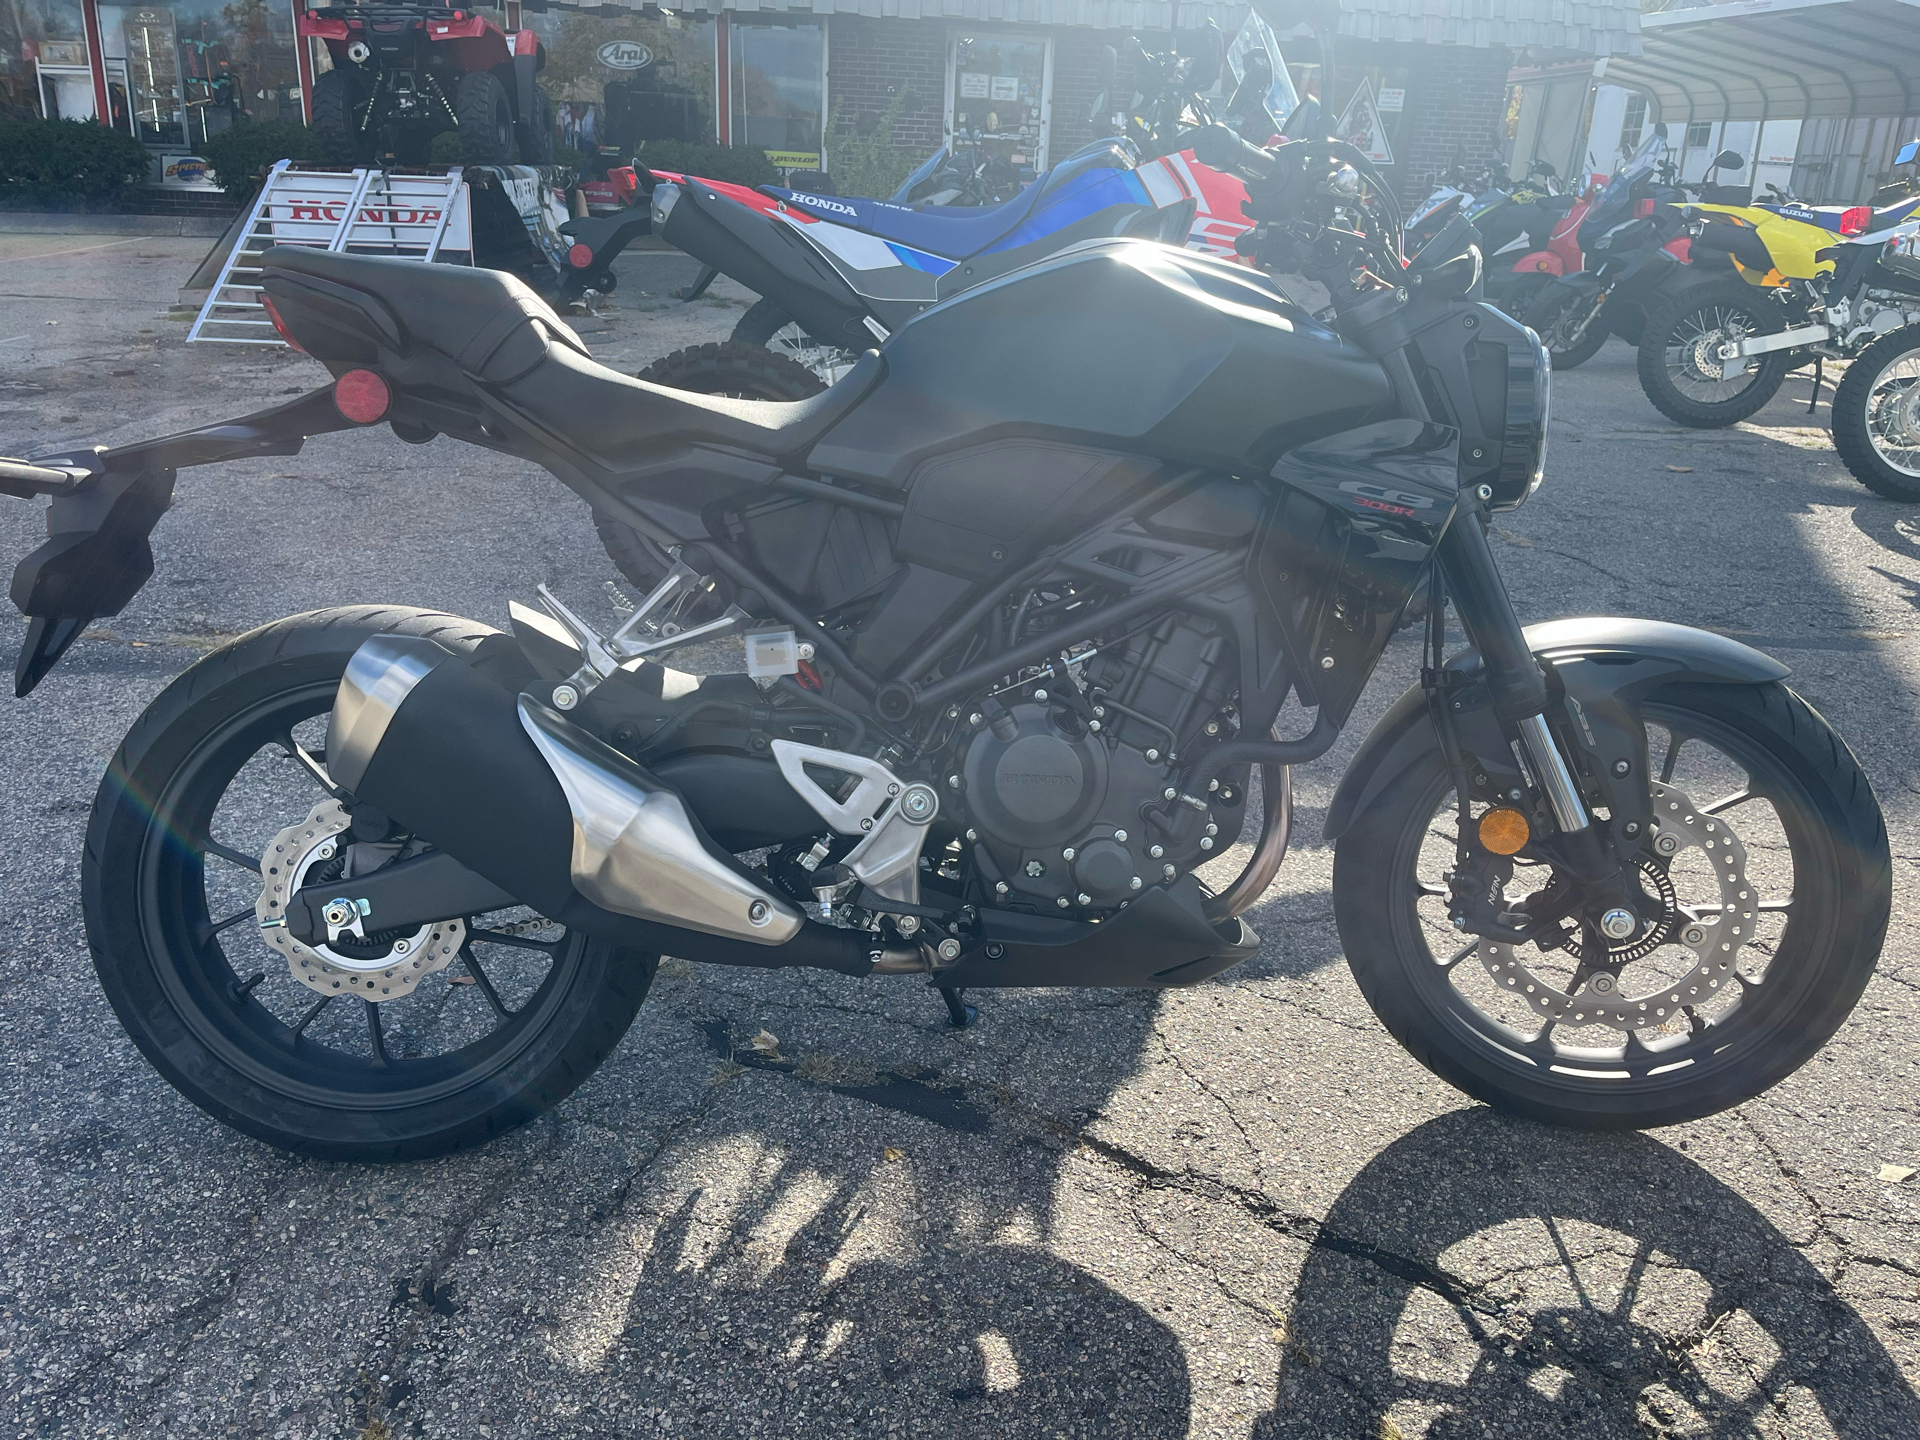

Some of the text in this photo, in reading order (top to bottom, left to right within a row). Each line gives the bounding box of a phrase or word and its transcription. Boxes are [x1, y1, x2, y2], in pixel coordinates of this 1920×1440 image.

[603, 45, 646, 60] Arai
[288, 199, 452, 226] HONDA
[790, 192, 857, 217] HONDA
[1779, 207, 1814, 219] SUZUKI
[1352, 496, 1415, 517] 300R
[1568, 695, 1597, 747] ABS
[1002, 773, 1078, 786] HONDA
[1487, 874, 1502, 906] NISSIN
